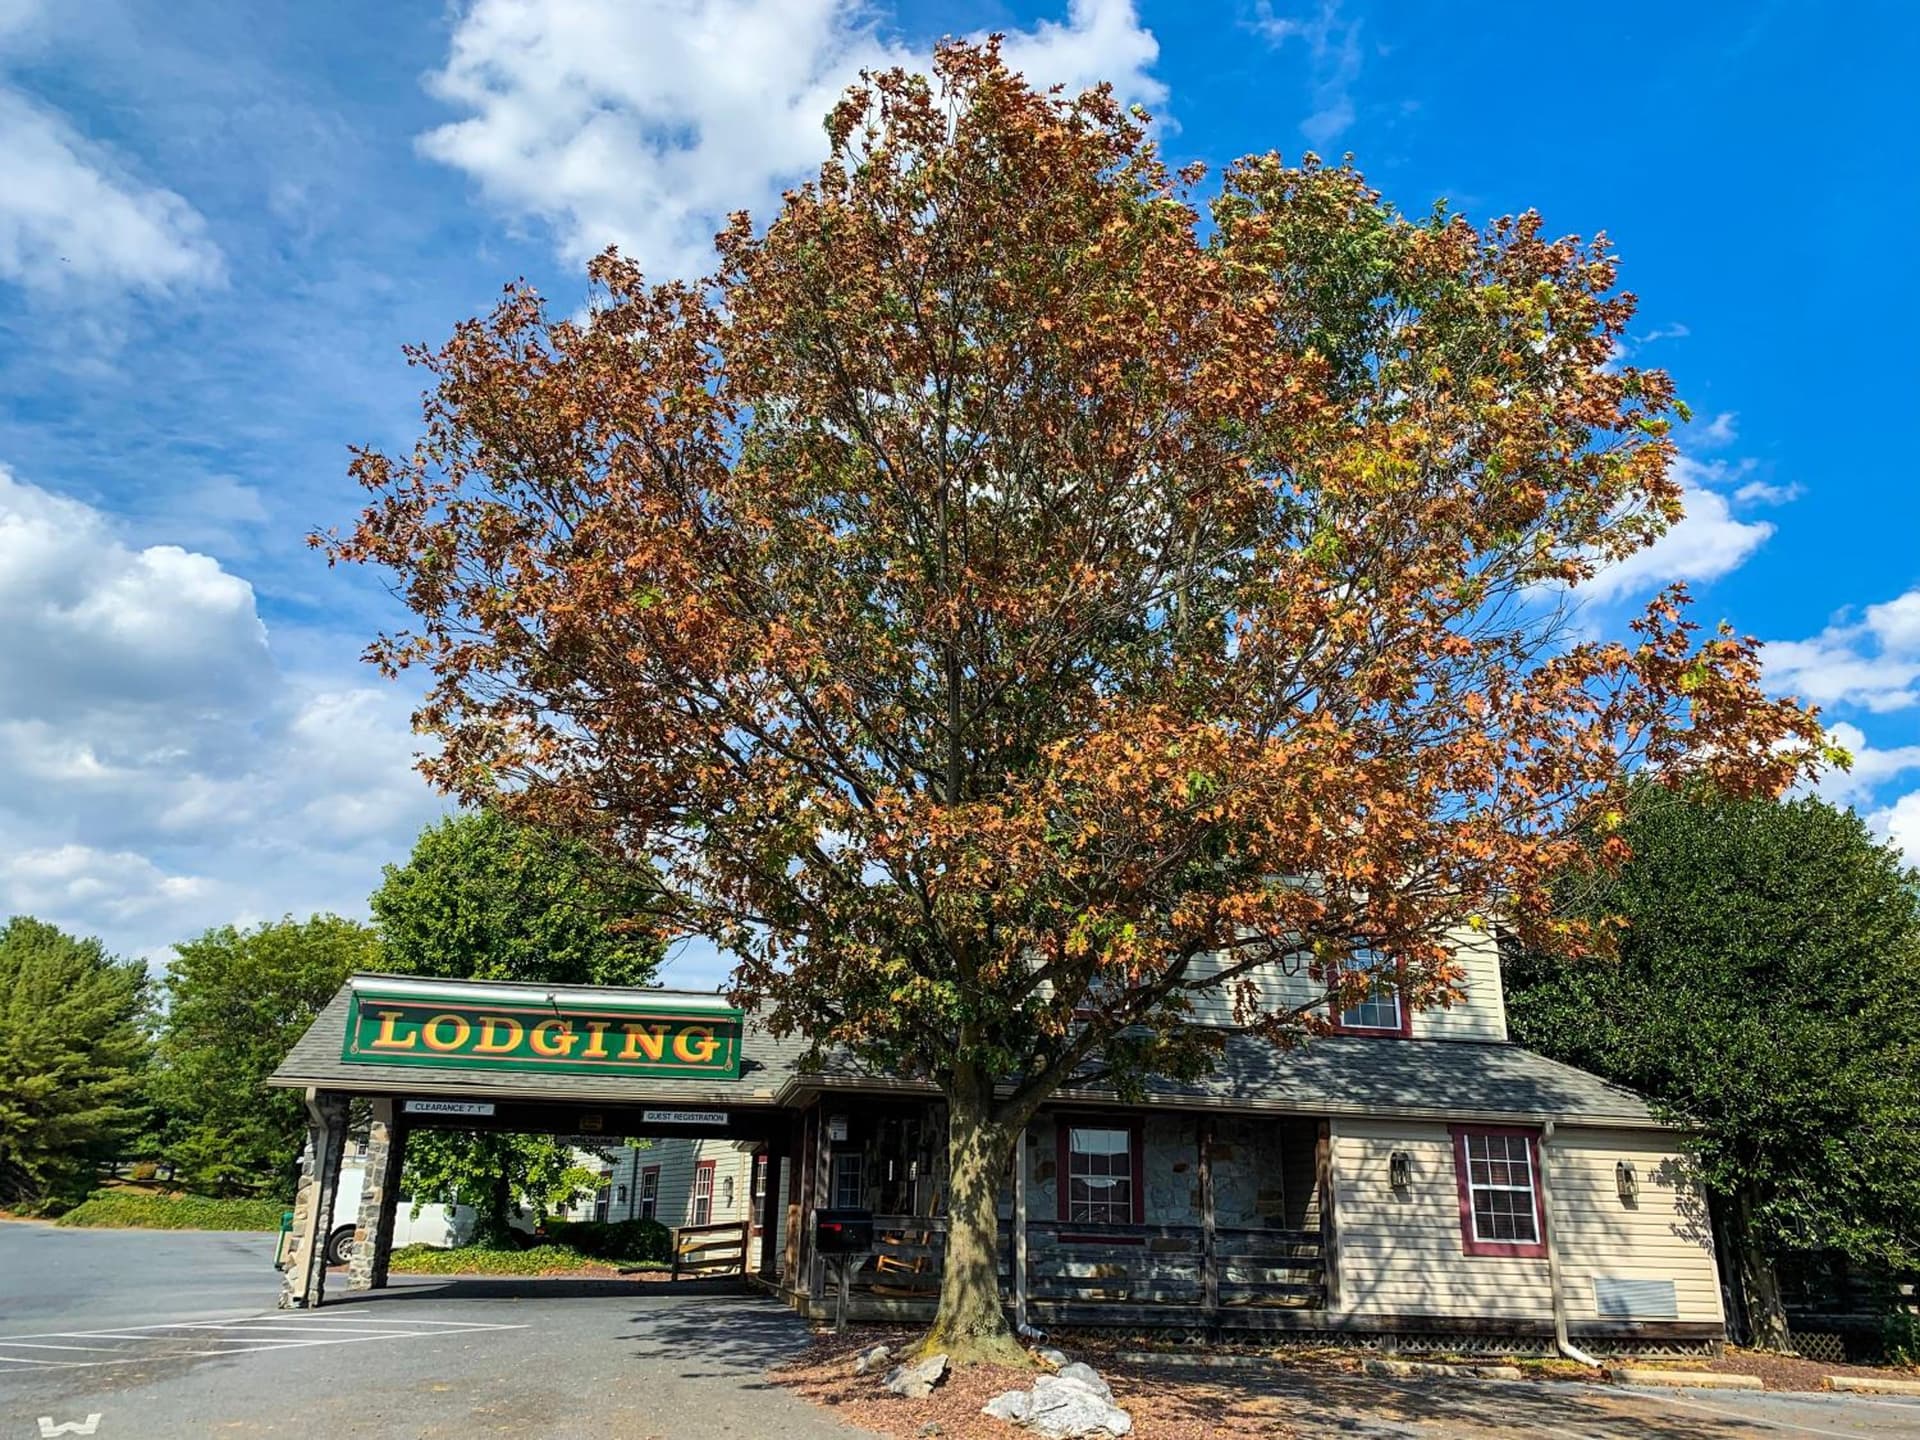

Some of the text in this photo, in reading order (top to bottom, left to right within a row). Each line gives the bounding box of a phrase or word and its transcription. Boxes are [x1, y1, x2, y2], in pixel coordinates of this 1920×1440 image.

[373, 1011, 720, 1062] LODGING
[415, 1102, 465, 1112] CLEARANCE
[647, 1112, 724, 1121] GUEST REGISTRATION
